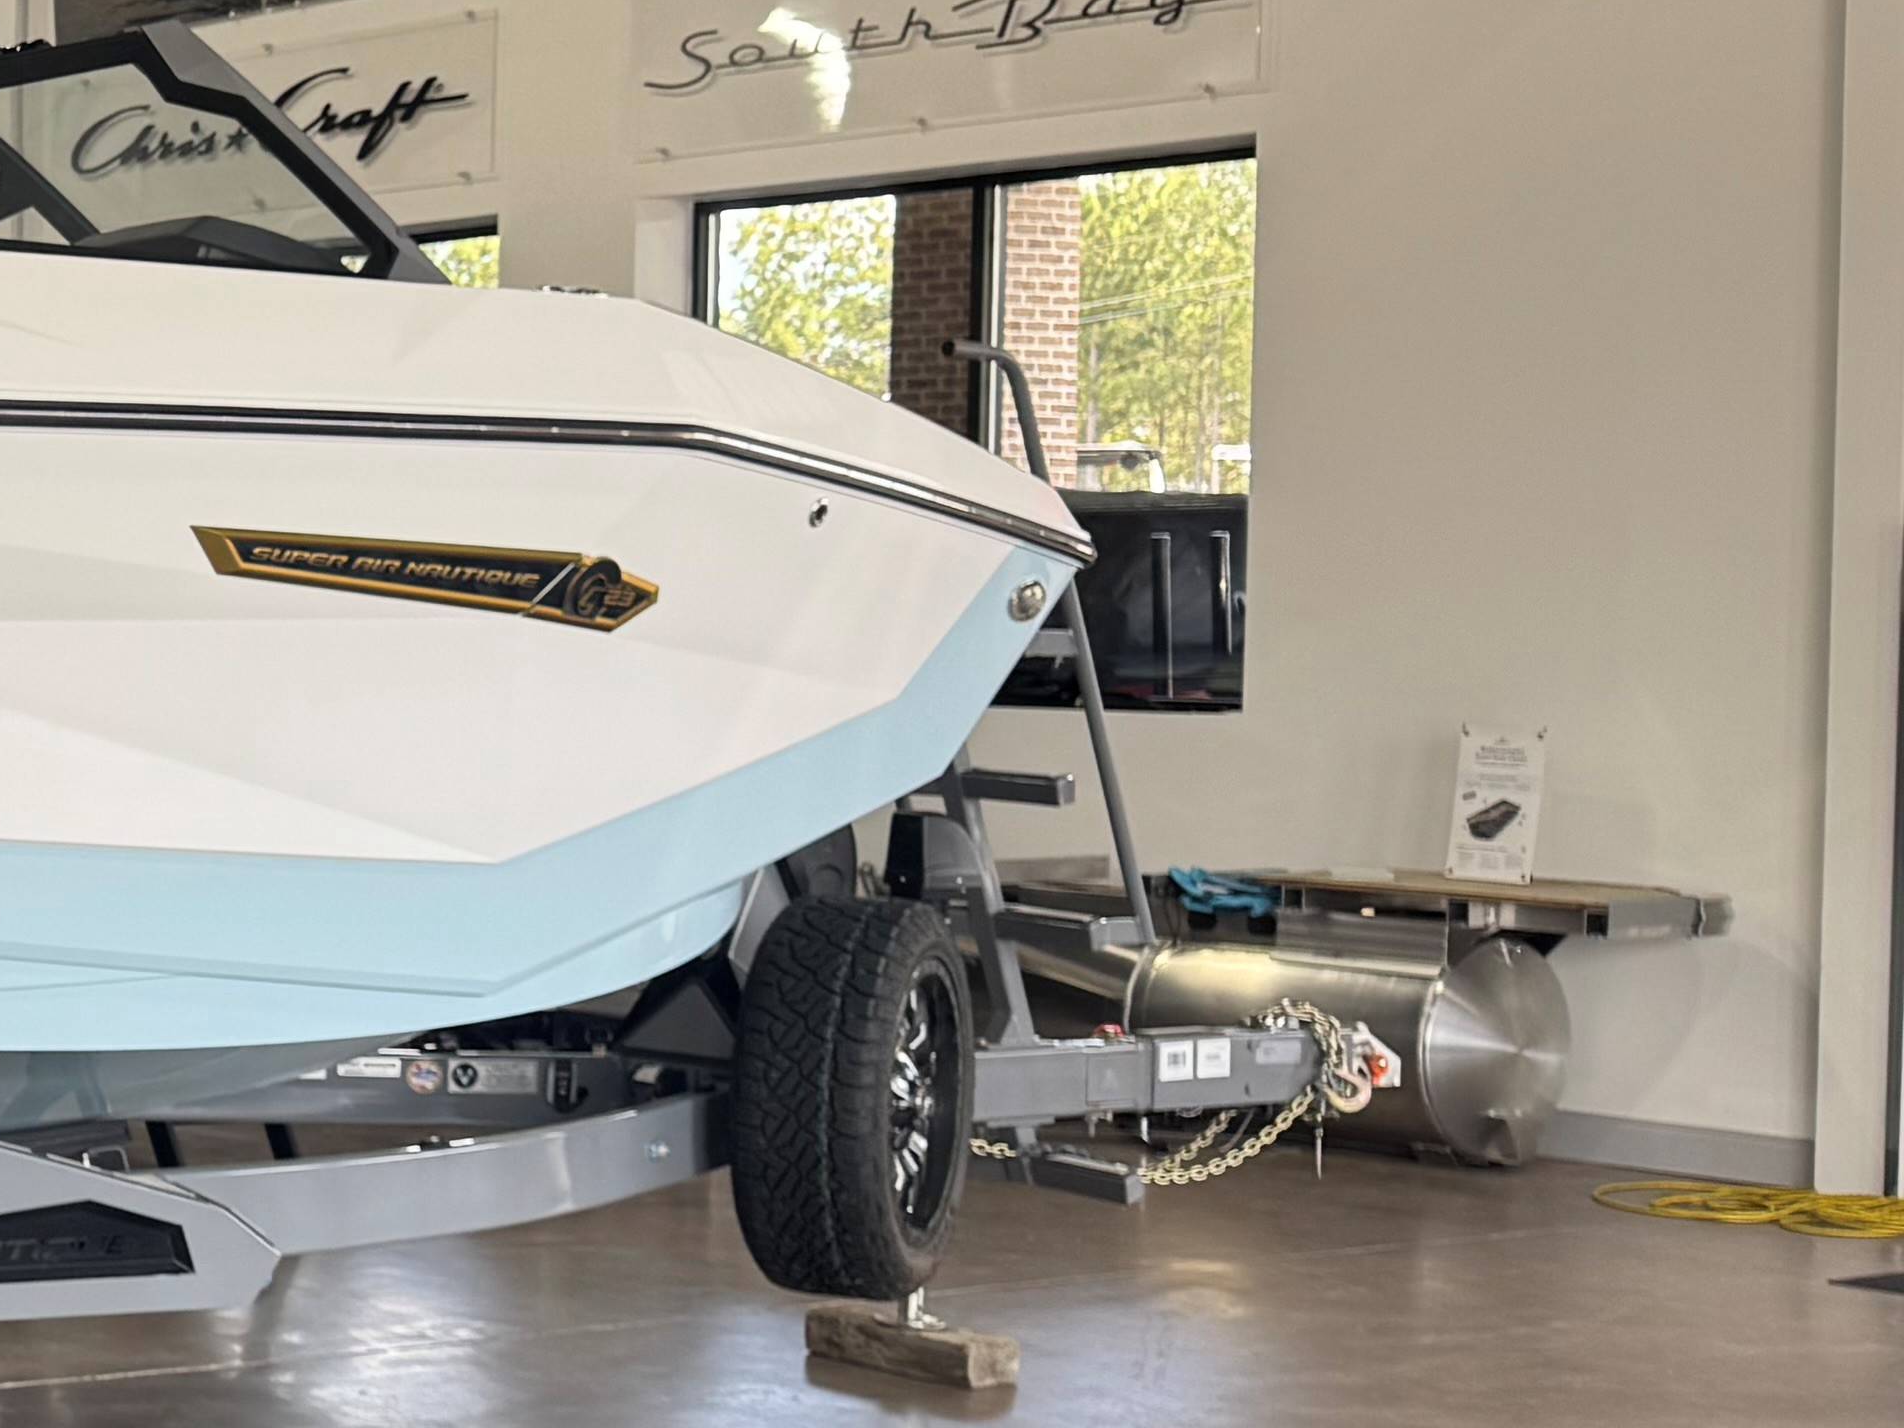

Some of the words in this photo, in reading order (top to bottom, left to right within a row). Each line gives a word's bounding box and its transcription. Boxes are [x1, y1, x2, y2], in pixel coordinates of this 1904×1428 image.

[644, 8, 962, 92] South
[70, 103, 219, 177] Chris
[250, 546, 350, 569] SUPER
[350, 556, 403, 574] AIR
[403, 560, 541, 589] NAUTIQUE
